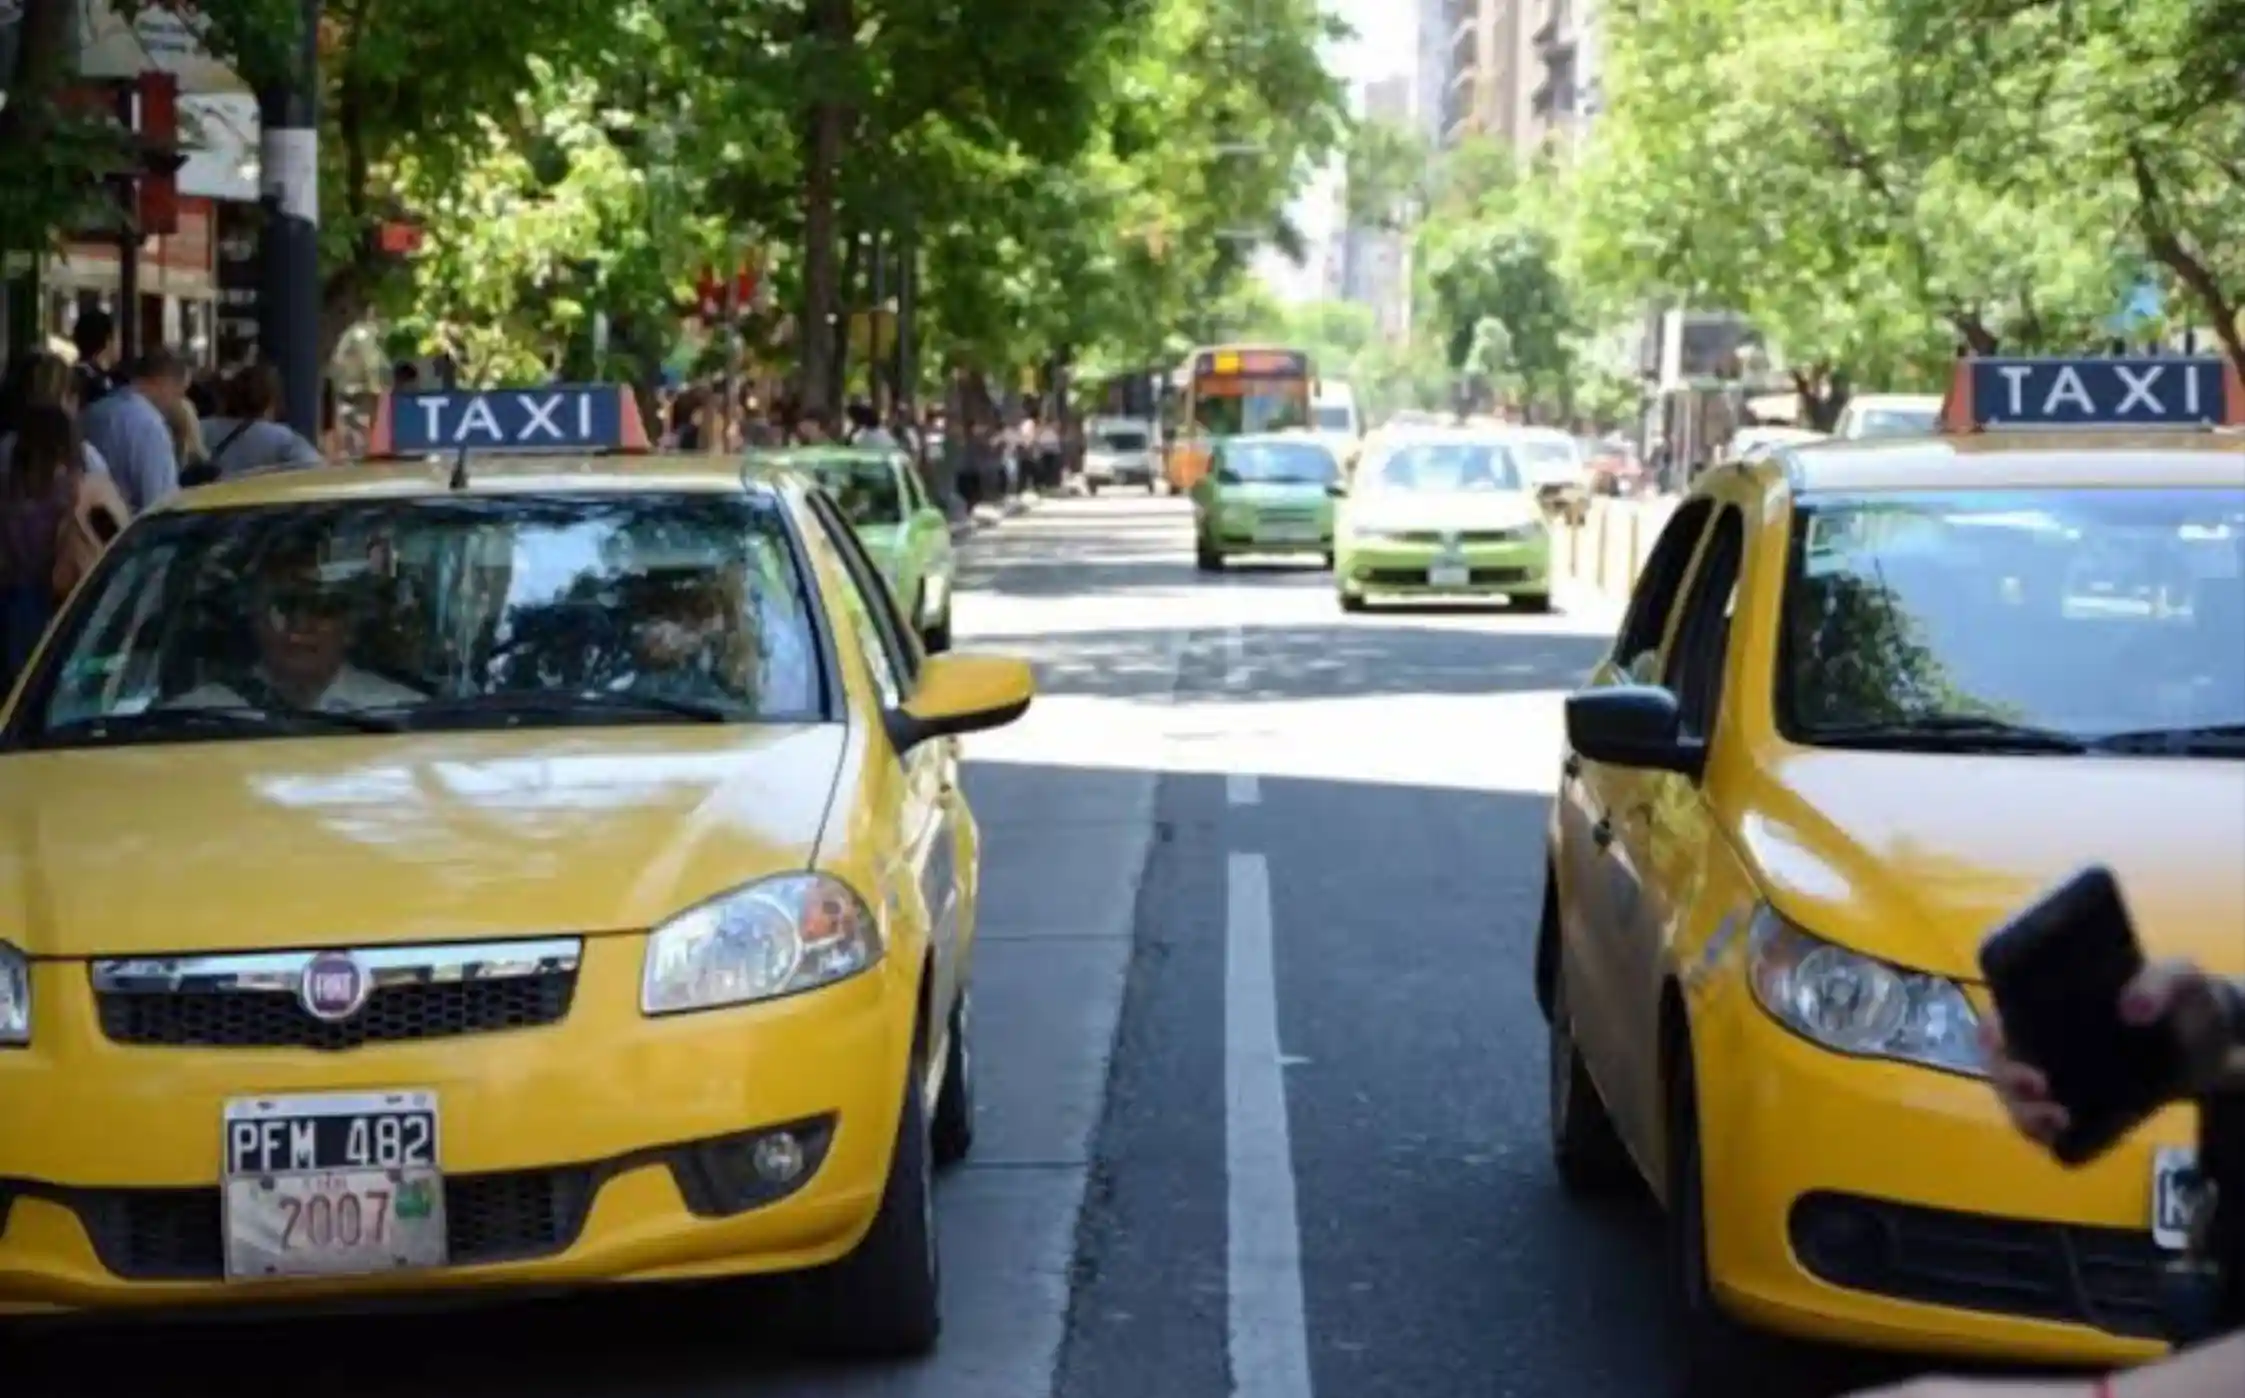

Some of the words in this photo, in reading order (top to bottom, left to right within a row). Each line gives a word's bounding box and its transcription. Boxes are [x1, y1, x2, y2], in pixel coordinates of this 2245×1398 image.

[416, 393, 594, 443] TAXI
[1998, 364, 2201, 416] TAXI
[233, 1120, 317, 1174] PFM
[345, 1114, 430, 1168] 482
[278, 1190, 390, 1250] 2007
